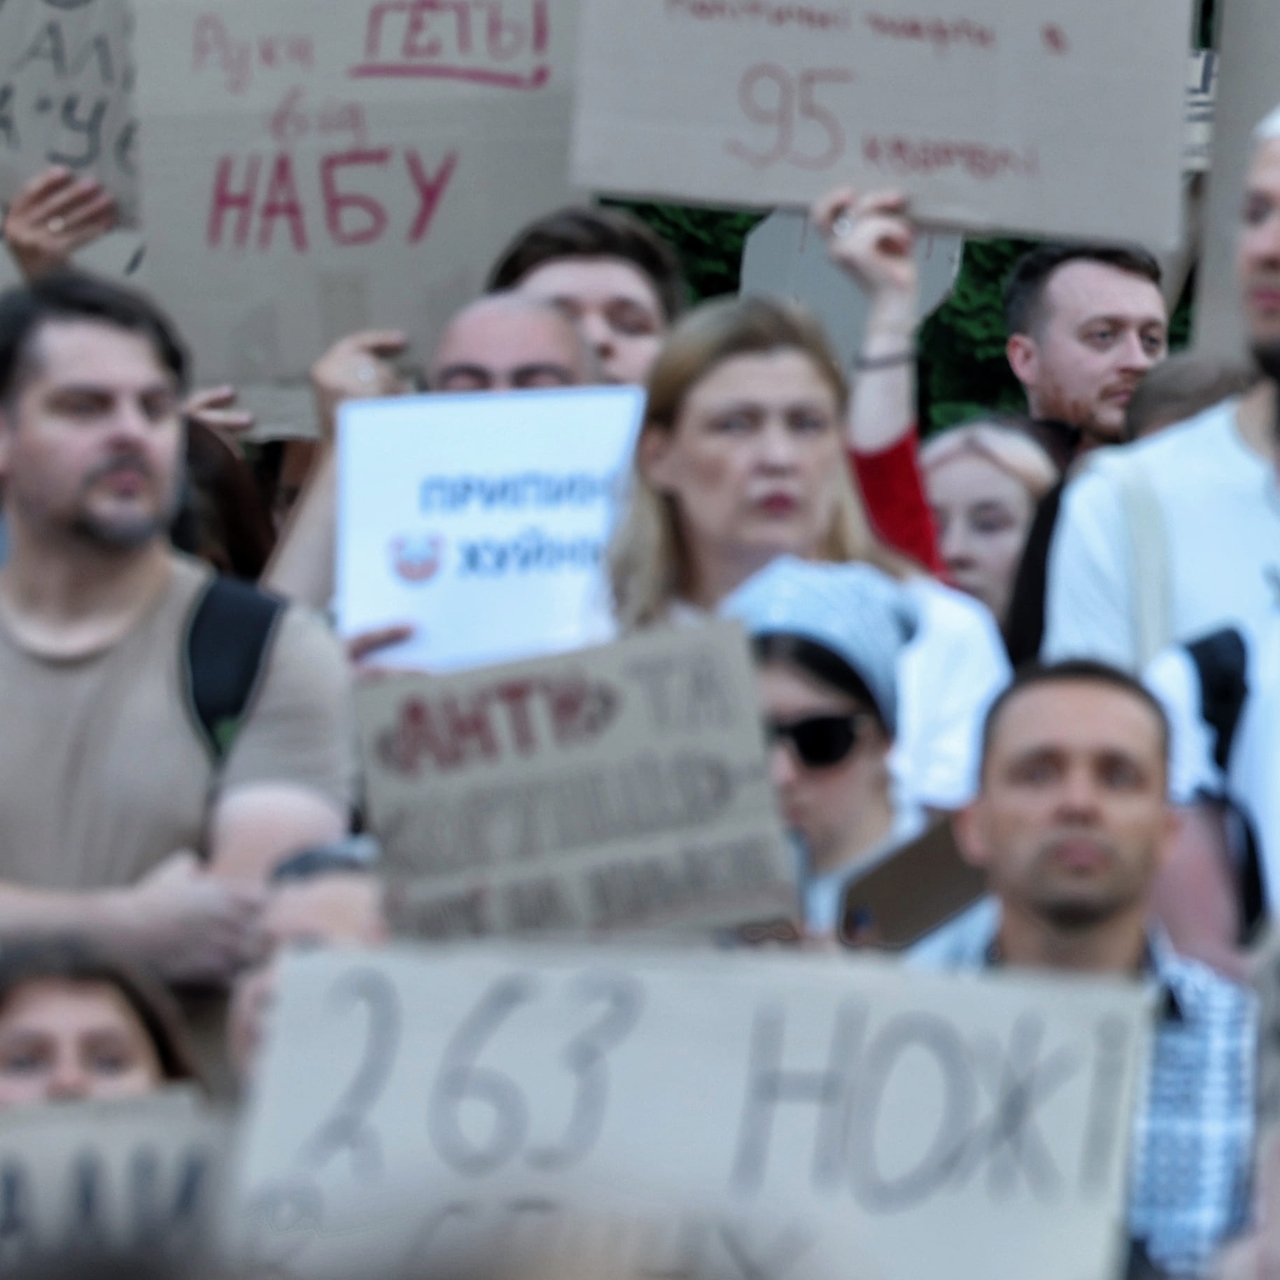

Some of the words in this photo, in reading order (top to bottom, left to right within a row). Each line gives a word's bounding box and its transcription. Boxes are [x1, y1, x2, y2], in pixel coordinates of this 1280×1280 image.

[723, 62, 855, 171] 95
[206, 147, 457, 252] НАБУ
[300, 967, 645, 1181] 263
[731, 992, 1129, 1214] НОЖІ
